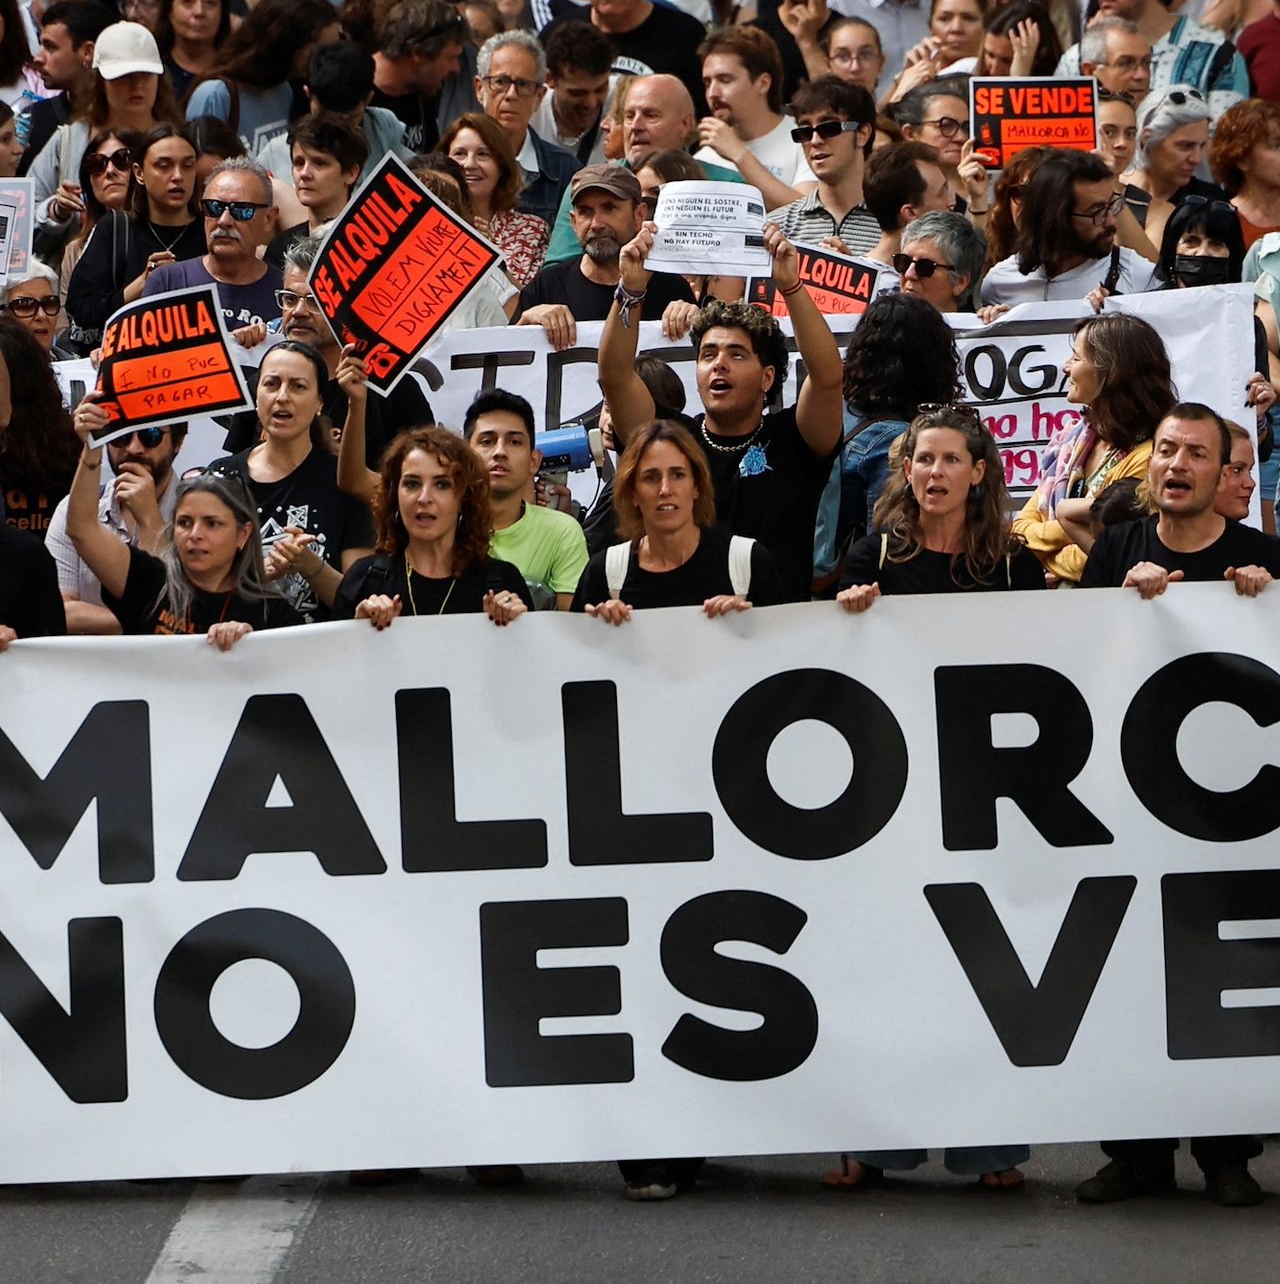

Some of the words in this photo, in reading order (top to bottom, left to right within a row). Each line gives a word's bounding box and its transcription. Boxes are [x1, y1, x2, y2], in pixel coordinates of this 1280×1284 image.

[975, 87, 1004, 114] SE
[1008, 87, 1093, 114] VENDE
[1007, 125, 1069, 138] MALLORCA
[327, 172, 424, 292] ALQUILA
[314, 264, 344, 318] SE
[363, 254, 425, 317] VOLEM
[832, 298, 851, 314] PUC
[116, 300, 216, 352] ALQUILA
[147, 366, 172, 381] NO
[187, 357, 219, 371] PUC
[144, 385, 213, 408] PAGAR
[479, 889, 820, 1087] ES
